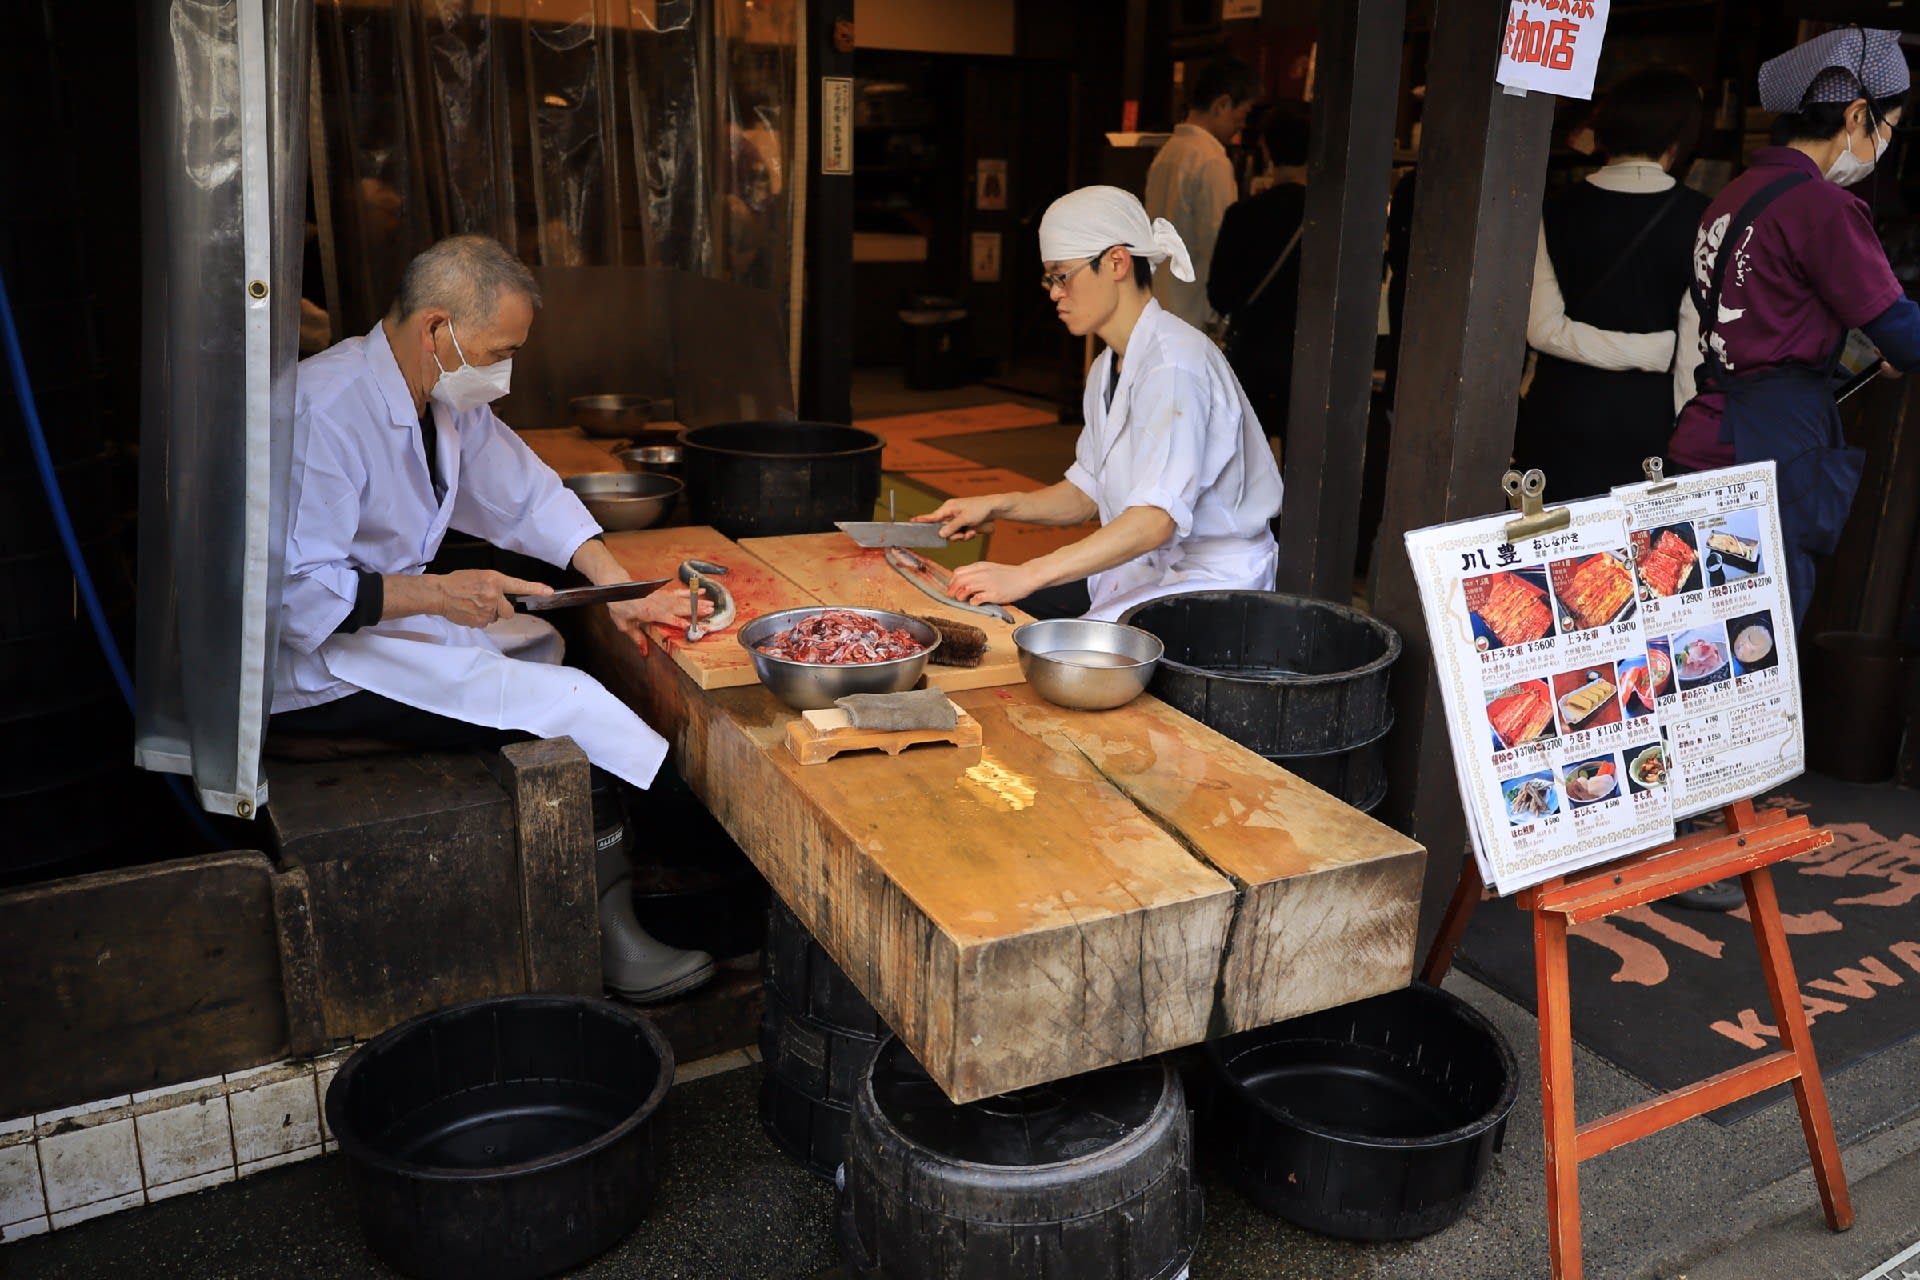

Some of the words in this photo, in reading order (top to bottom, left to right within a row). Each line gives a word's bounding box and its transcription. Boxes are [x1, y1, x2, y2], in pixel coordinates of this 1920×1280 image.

[1533, 533, 1578, 550] おしながき
[1461, 543, 1522, 571] 川豊
[1753, 576, 1772, 588] ¥2700
[1680, 592, 1703, 605] ¥2900
[1568, 631, 1599, 645] 上うな重
[1609, 622, 1636, 635] ¥3900
[1481, 648, 1524, 664] 特上うな重
[1528, 639, 1555, 653] ¥5600
[1657, 694, 1676, 707] ¥200
[1597, 722, 1623, 736] ¥1100
